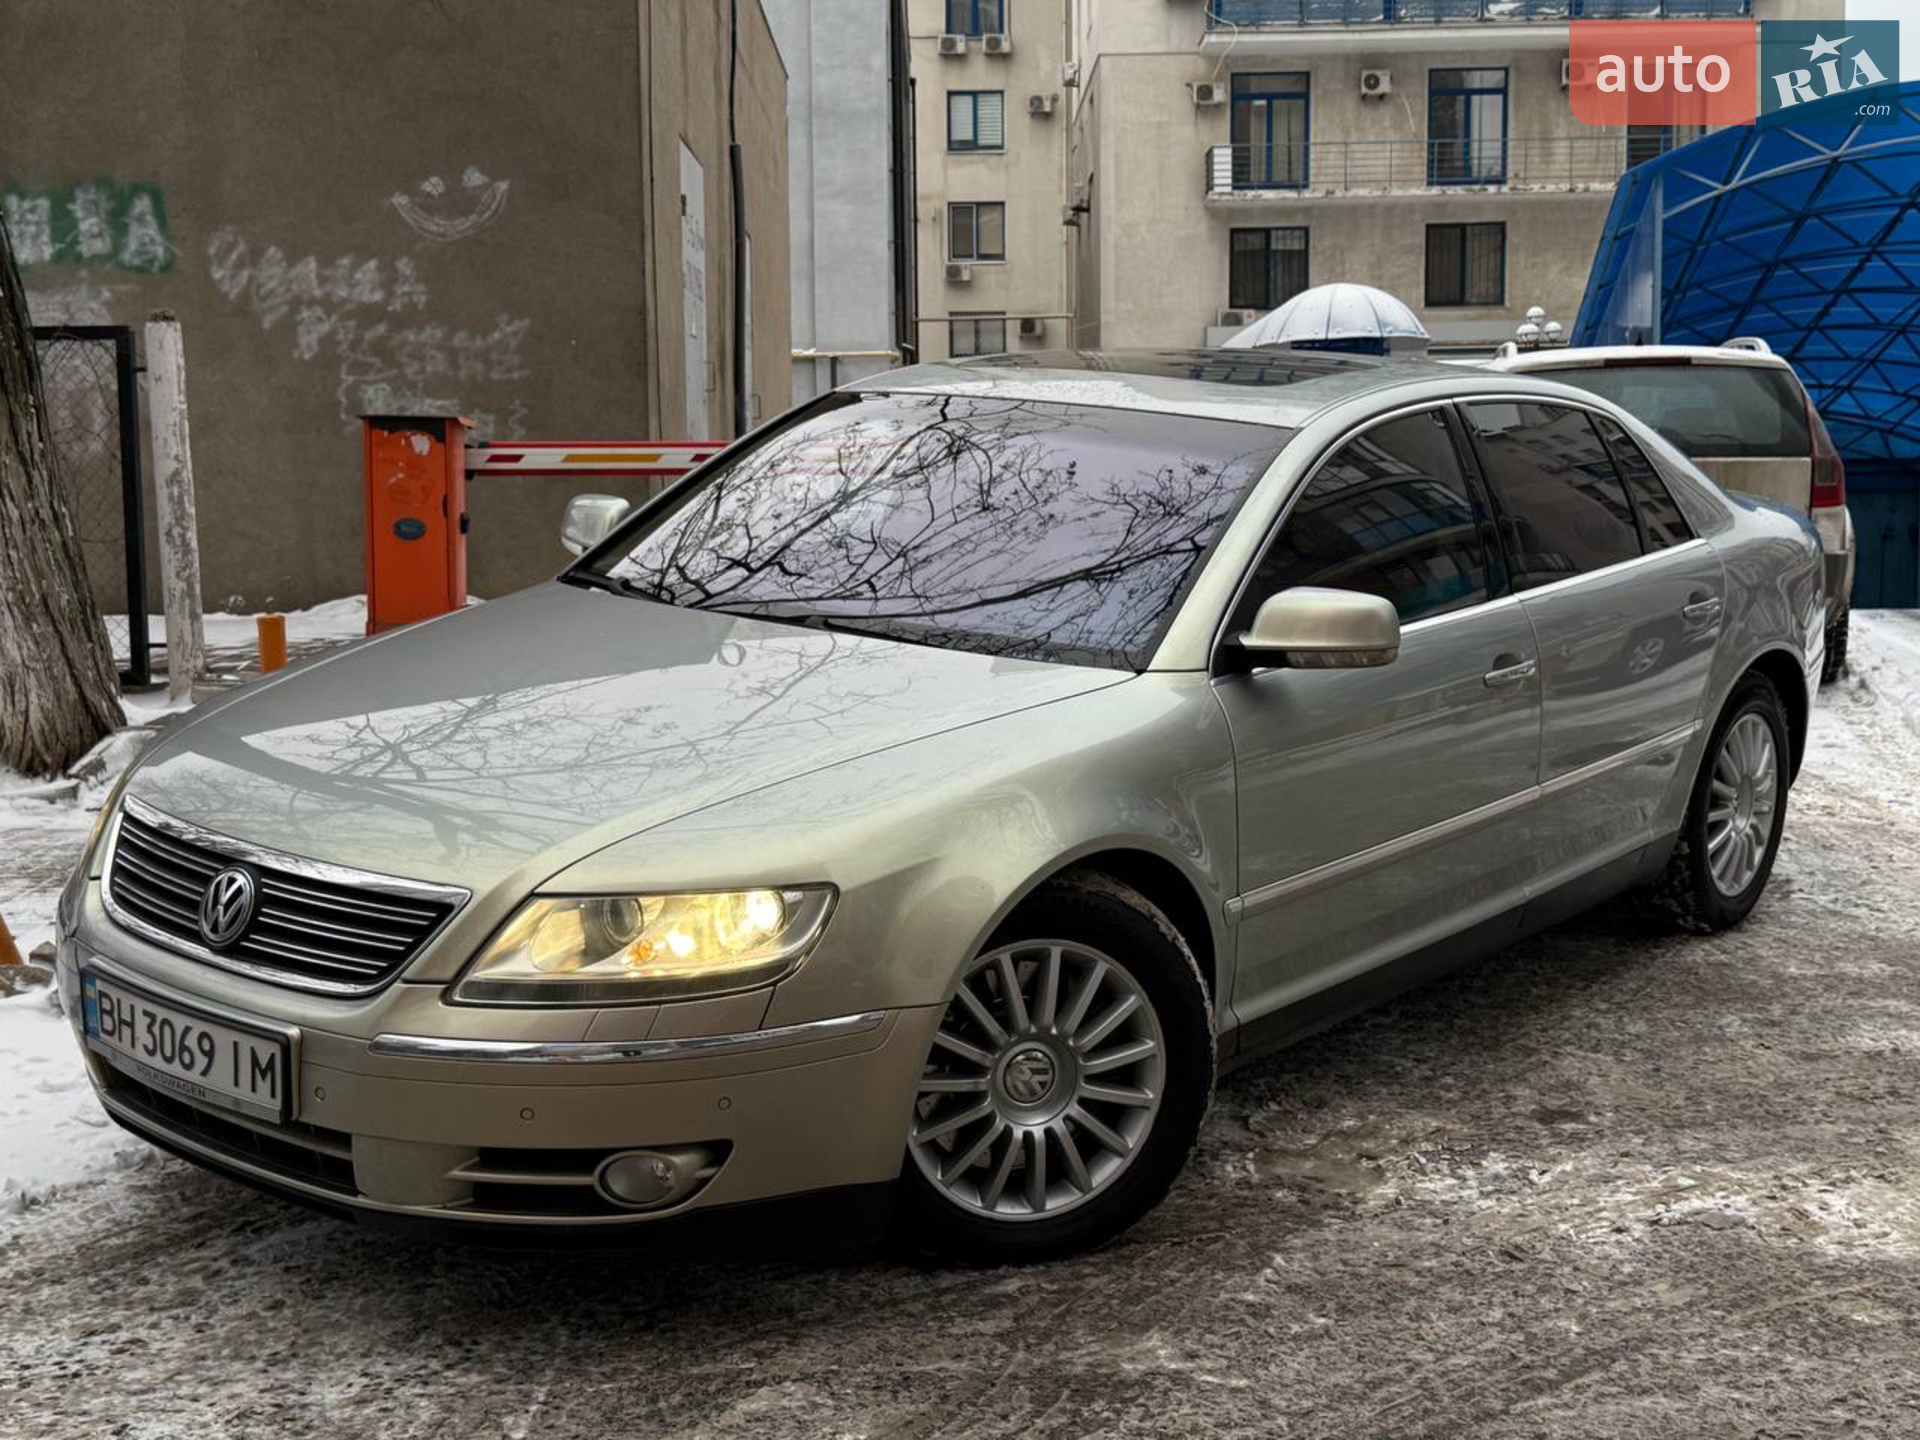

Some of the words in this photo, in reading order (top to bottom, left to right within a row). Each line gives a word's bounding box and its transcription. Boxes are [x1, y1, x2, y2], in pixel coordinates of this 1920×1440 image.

[98, 989, 136, 1050] BH
[142, 1008, 216, 1077] 3069
[232, 1040, 277, 1099] IM
